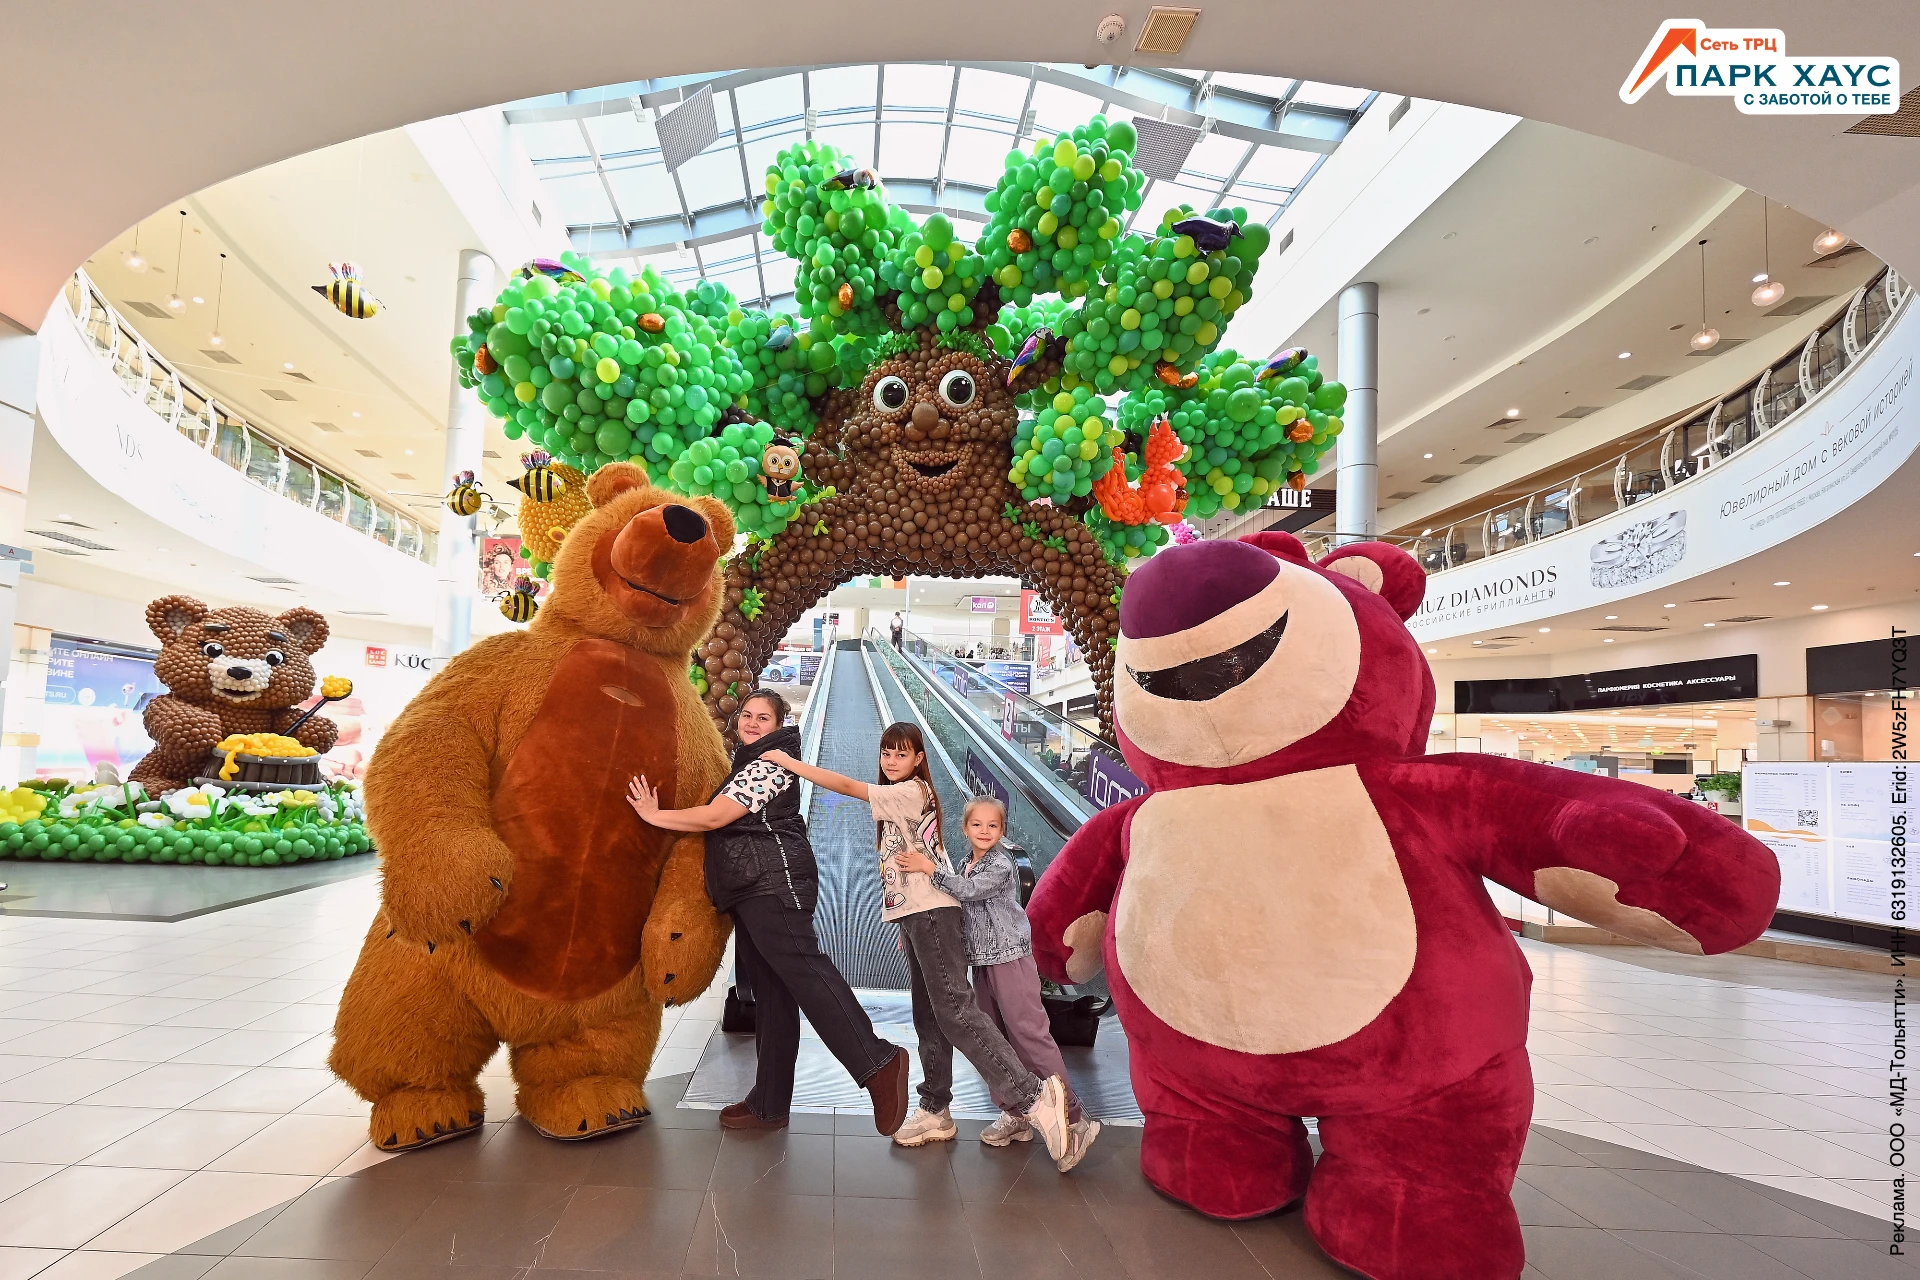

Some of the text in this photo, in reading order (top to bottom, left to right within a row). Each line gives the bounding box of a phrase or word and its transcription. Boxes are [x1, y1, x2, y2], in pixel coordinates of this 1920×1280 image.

[1719, 467, 1790, 520] Ювелирный
[1793, 458, 1817, 484] дом
[1831, 408, 1872, 457] вековой
[1872, 354, 1914, 421] историей
[1451, 565, 1558, 608] DIAMONDS
[1476, 587, 1557, 614] БРИЛЛИАНТЫ
[1642, 679, 1684, 689] КОСМЕТИКА
[1686, 674, 1736, 685] АКСЕССУАРЫ
